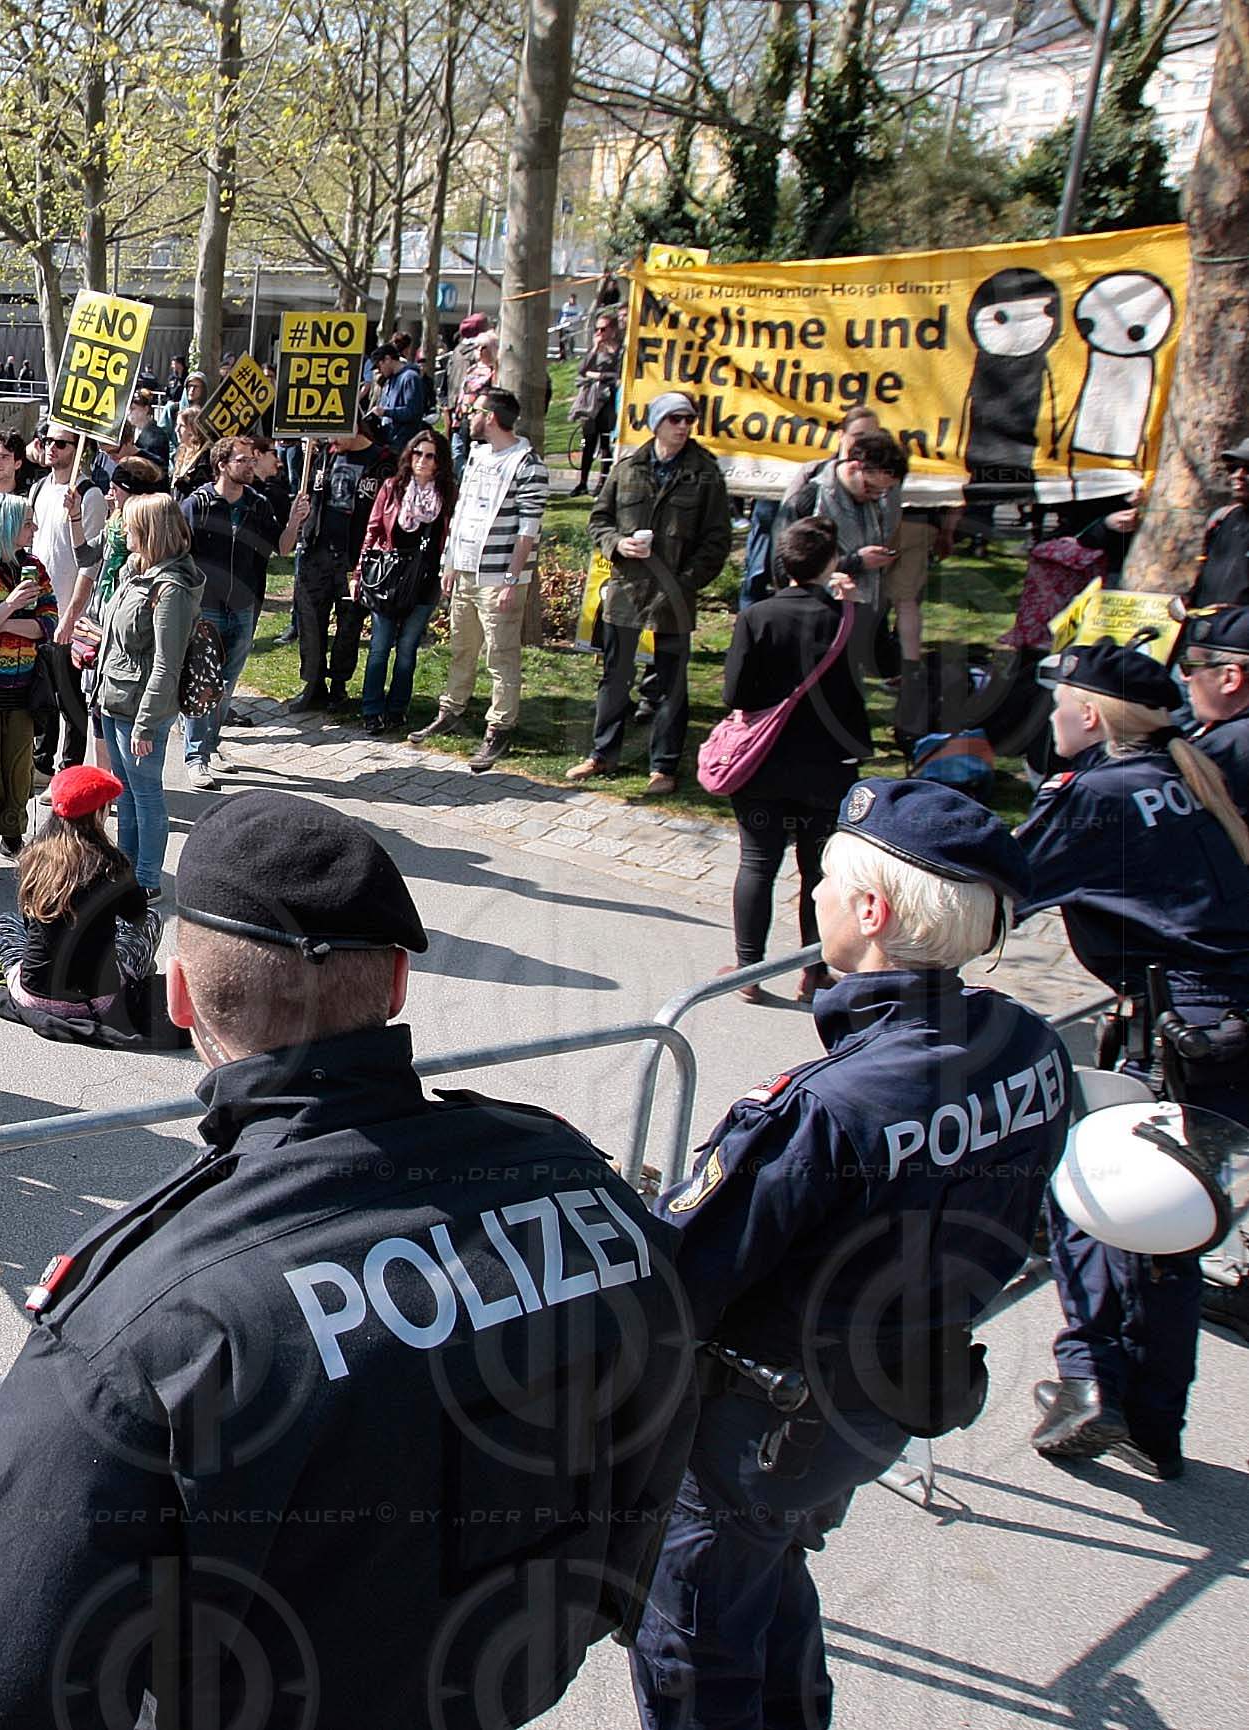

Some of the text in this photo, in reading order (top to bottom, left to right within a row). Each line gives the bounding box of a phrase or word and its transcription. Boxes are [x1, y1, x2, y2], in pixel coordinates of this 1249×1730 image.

[77, 303, 138, 342] #NO
[288, 320, 355, 348] #NO
[845, 304, 949, 351] und
[69, 341, 130, 387] PEG
[235, 364, 272, 402] #NO
[288, 358, 350, 386] PEG
[62, 375, 117, 421] IDA
[221, 384, 253, 427] PEG
[287, 388, 345, 416] IDA
[884, 1049, 1065, 1182] POLIZEI
[283, 1187, 651, 1381] POLIZEI
